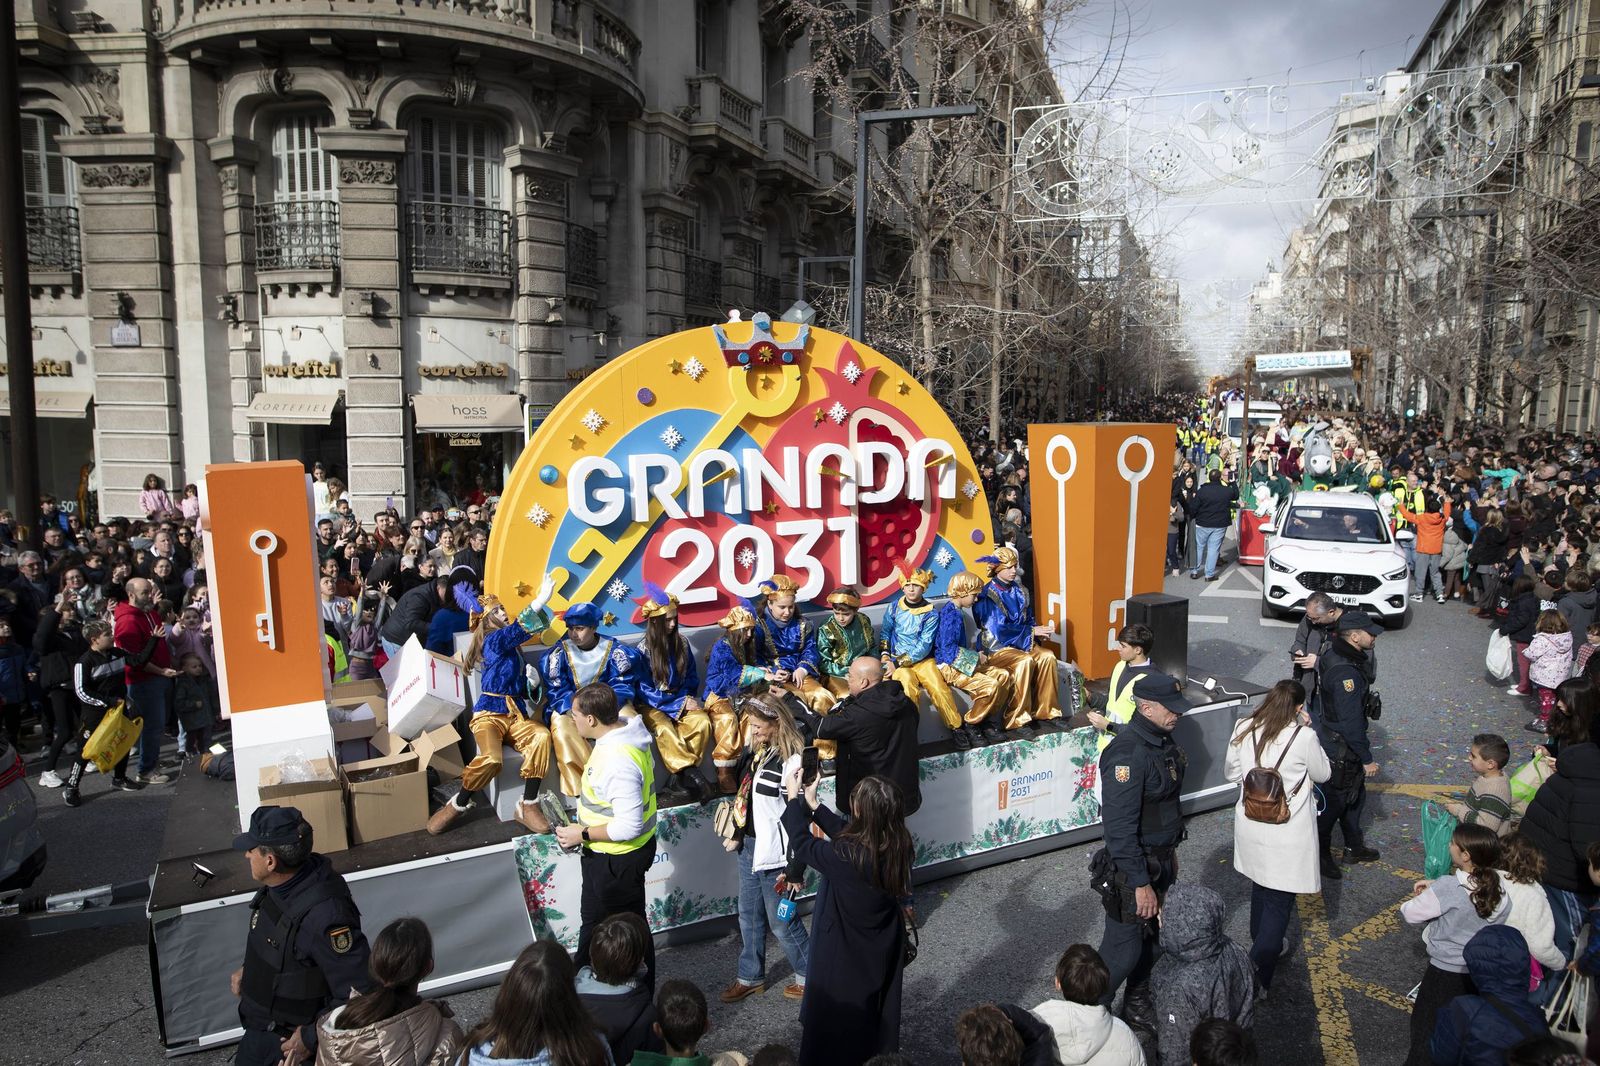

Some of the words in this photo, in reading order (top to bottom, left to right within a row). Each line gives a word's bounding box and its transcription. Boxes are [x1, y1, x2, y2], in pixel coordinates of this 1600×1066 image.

[263, 361, 338, 377] cortefiel
[418, 362, 508, 378] cortefiel
[254, 403, 327, 413] CORTEFIEL
[451, 404, 487, 416] hoss
[567, 438, 957, 526] GRANADA
[659, 516, 858, 605] 2031
[1011, 770, 1053, 786] GRANADA
[1011, 785, 1030, 798] 2031
